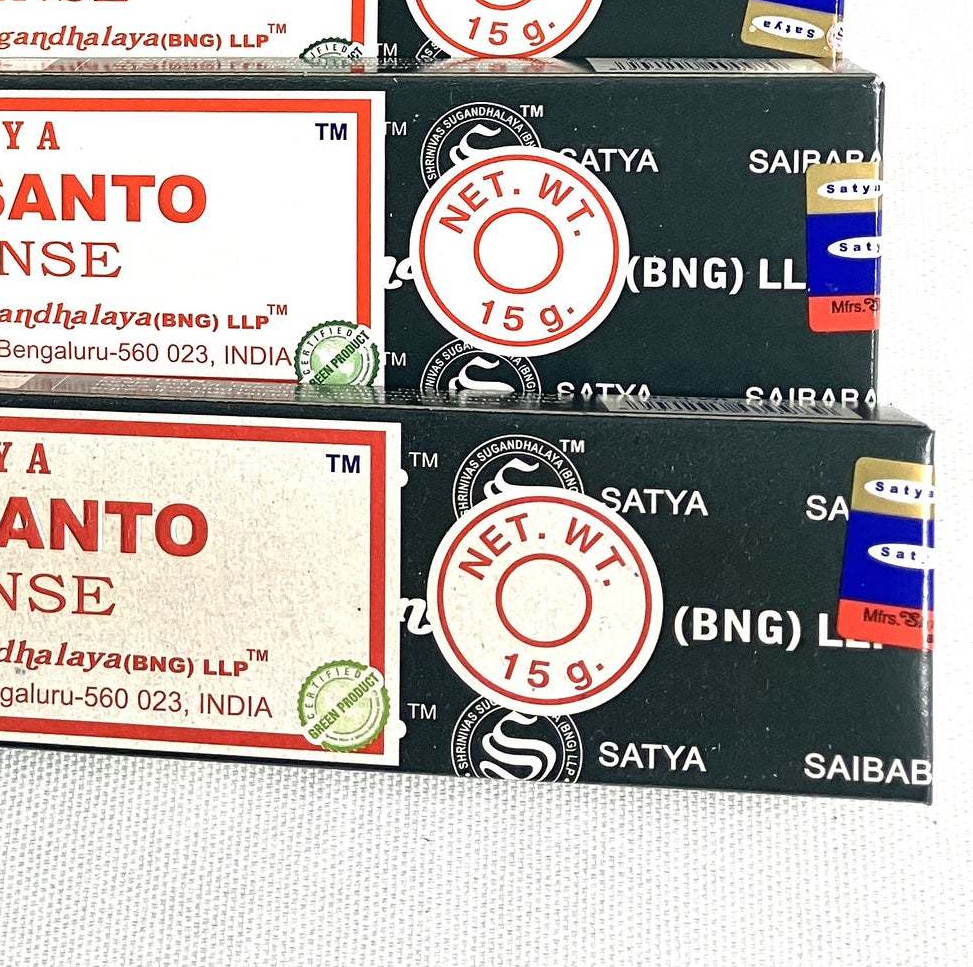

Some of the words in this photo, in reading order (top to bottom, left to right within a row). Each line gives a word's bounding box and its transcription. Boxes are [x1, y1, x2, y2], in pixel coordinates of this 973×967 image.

[469, 17, 507, 45] 15
[520, 105, 543, 117] TM
[315, 123, 347, 140] TM
[439, 171, 524, 239] NET.
[534, 173, 594, 241] WT.
[625, 256, 744, 295] (BNG)
[483, 301, 523, 331] 15
[168, 344, 214, 367] 023,
[226, 345, 292, 366] INDIA
[559, 440, 584, 452] TM
[326, 454, 360, 473] TM
[601, 487, 709, 516] SATYA
[459, 513, 550, 586] NET.
[561, 518, 625, 591] WT.
[673, 605, 801, 652] (BNG)
[505, 654, 549, 688] 15
[138, 690, 188, 716] 023,
[200, 693, 272, 718] INDIA
[336, 672, 379, 713] PRODUCT
[599, 742, 706, 771] SATYA
[803, 751, 933, 787] SAIBAB
